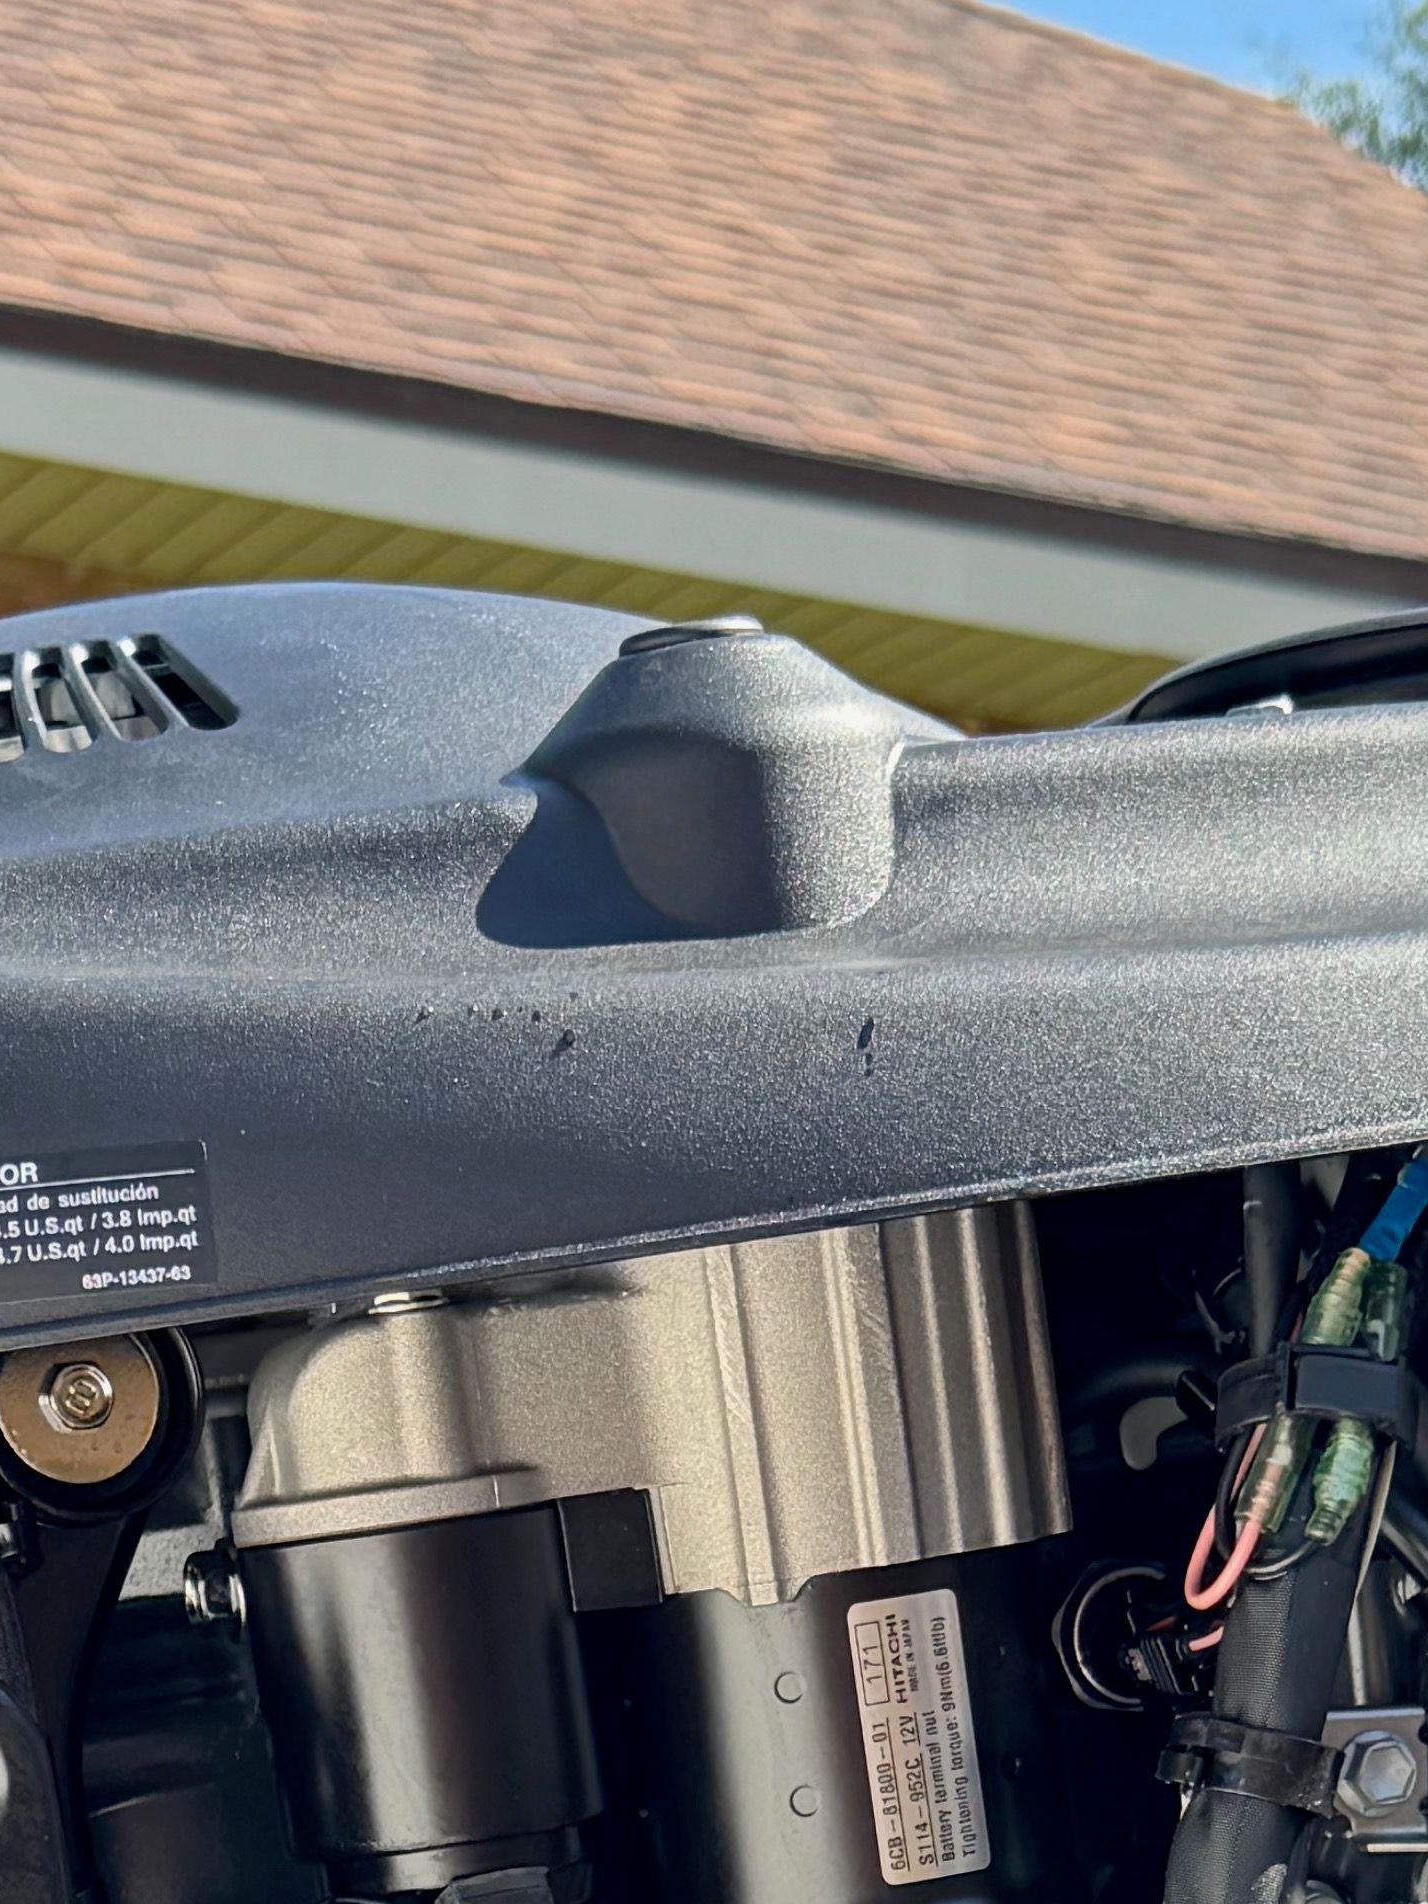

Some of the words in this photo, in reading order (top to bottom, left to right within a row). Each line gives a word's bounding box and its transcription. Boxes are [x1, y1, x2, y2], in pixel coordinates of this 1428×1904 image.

[27, 1194, 50, 1211] de
[58, 1182, 159, 1208] sustitución
[24, 1215, 84, 1236] U.S.qt
[101, 1209, 132, 1229] 3.8
[137, 1205, 197, 1227] Imp.qt
[27, 1240, 87, 1262] U.S.qt
[105, 1235, 135, 1253] 4.0
[139, 1230, 199, 1252] Imp.qt
[901, 1619, 913, 1648] JAPAN
[862, 1645, 883, 1683] 171
[885, 1614, 908, 1704] HITACHI
[906, 1652, 914, 1661] IN
[899, 1716, 917, 1745] 12V
[922, 1710, 938, 1736] nut
[946, 1717, 966, 1771] torque:
[926, 1742, 947, 1804] terminal
[954, 1776, 977, 1857] Tightening
[938, 1810, 956, 1862] Battery
